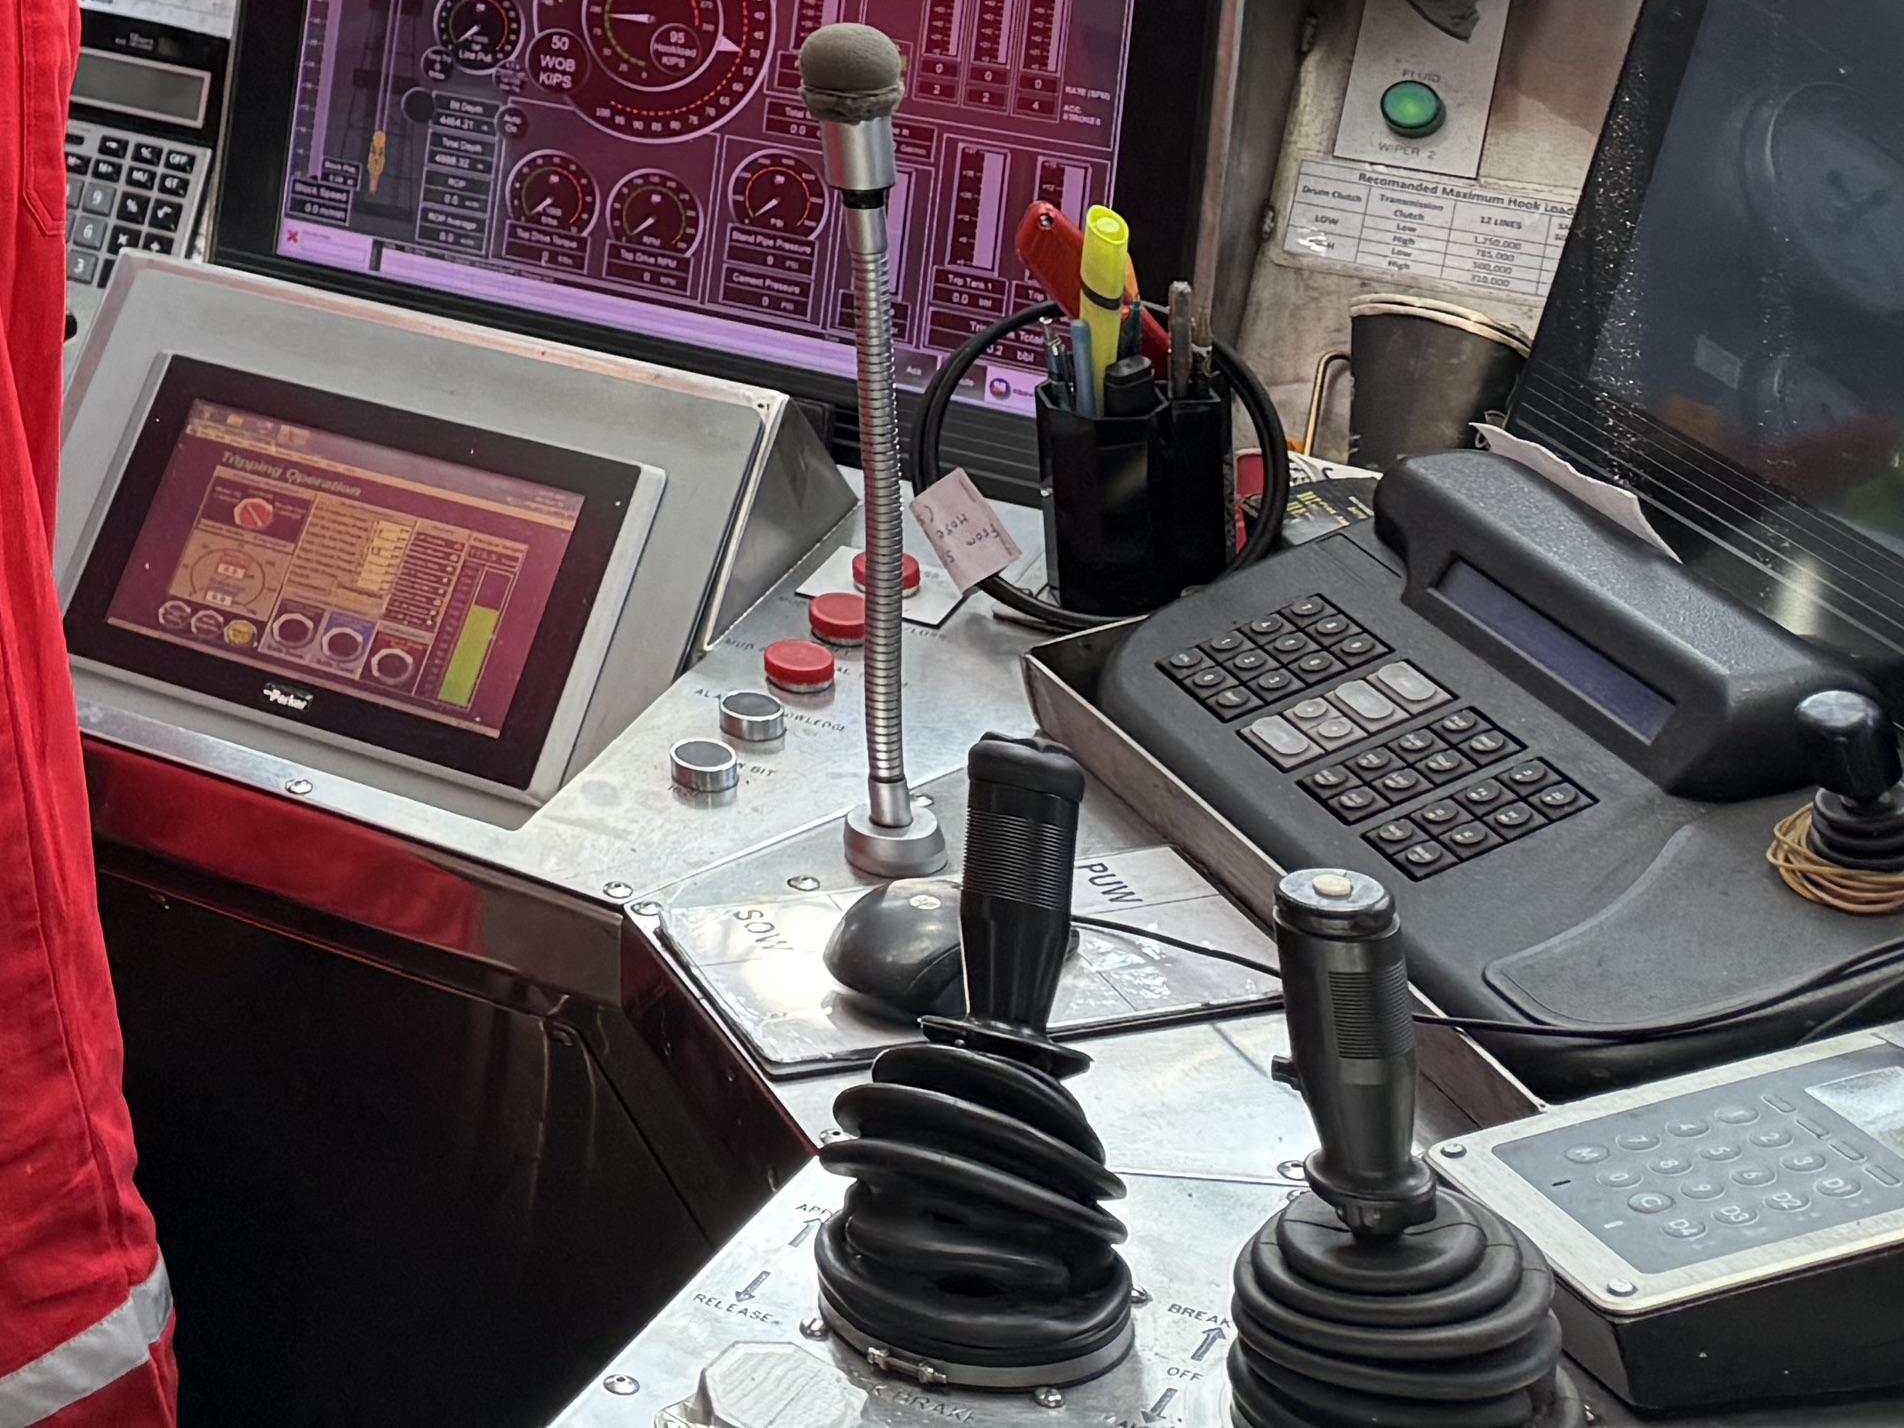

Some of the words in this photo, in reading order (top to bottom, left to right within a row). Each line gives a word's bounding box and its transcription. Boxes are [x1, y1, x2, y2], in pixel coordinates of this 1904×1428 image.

[551, 35, 569, 50] 50
[540, 55, 575, 72] WOB
[539, 72, 572, 88] KIPS
[1402, 69, 1441, 83] FLUID
[1378, 143, 1420, 158] WIPER
[1442, 186, 1505, 206] Maximum
[1508, 197, 1542, 211] Hook
[222, 451, 282, 479] Tripping
[285, 469, 361, 498] Operation
[749, 766, 777, 778] BIT
[1077, 862, 1144, 905] PUW
[692, 1292, 781, 1325] RELEASE
[1166, 1366, 1204, 1383] OFF
